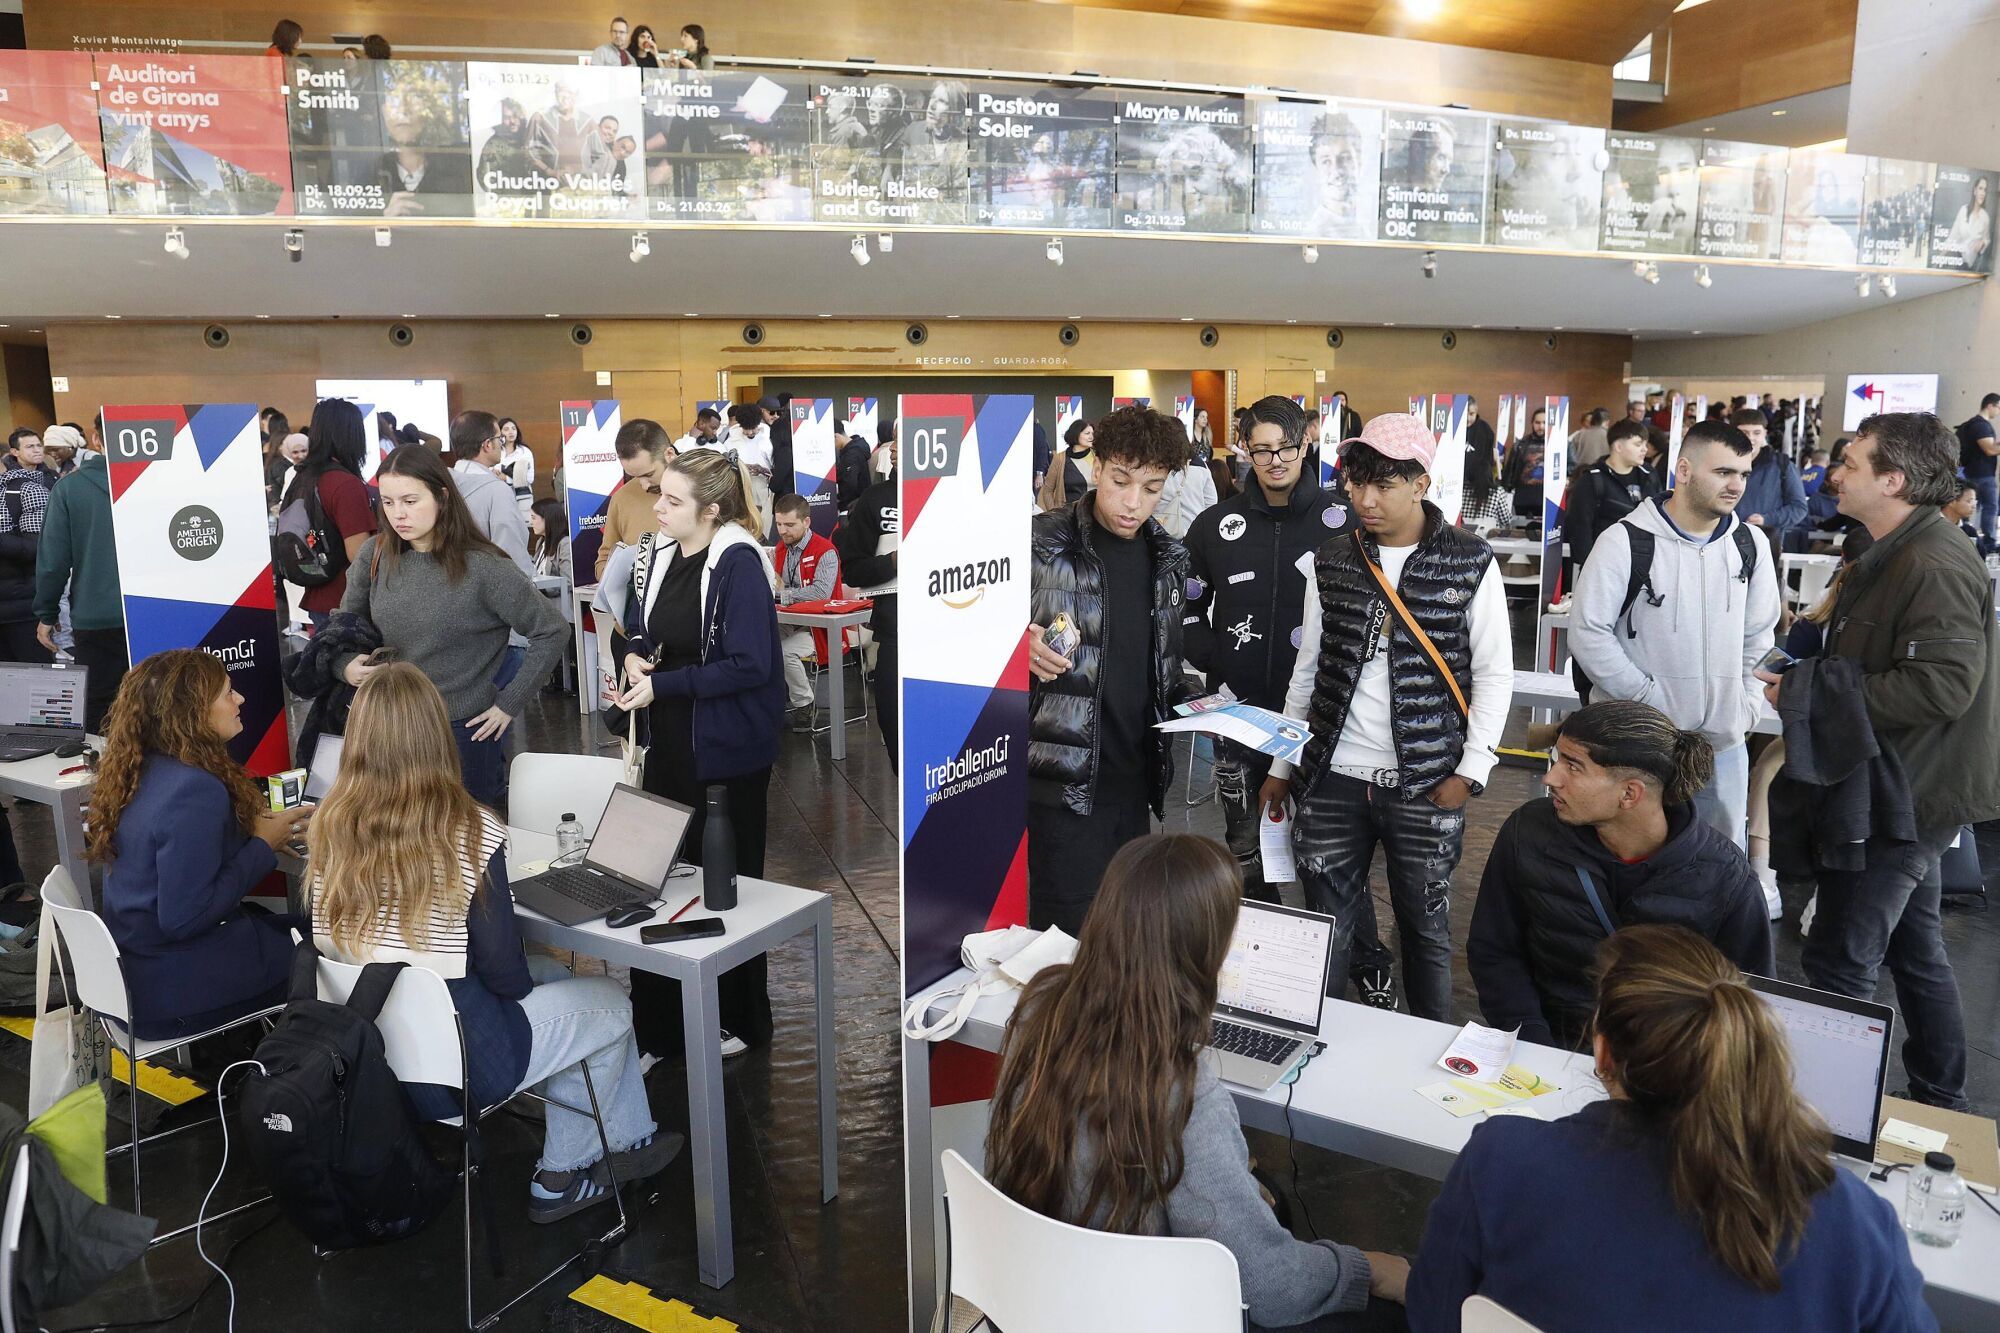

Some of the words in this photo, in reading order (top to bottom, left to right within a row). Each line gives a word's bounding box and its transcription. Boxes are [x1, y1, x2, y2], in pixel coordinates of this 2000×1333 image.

[73, 35, 107, 44] Xavier
[112, 36, 183, 46] Montsalvatge
[107, 63, 196, 84] Auditori
[295, 69, 346, 88] Patti
[109, 85, 138, 104] de
[142, 86, 219, 106] Girona
[653, 79, 712, 98] Maria
[842, 86, 889, 99] 28.11.25
[298, 90, 359, 110] Smith
[978, 94, 1060, 117] Pastora
[653, 101, 720, 119] Jaume
[1125, 102, 1180, 123] Mayte
[1183, 105, 1239, 125] Martín
[110, 107, 153, 127] vint
[157, 112, 211, 133] anys
[978, 117, 1033, 138] Soler
[483, 170, 560, 190] Chucho
[564, 171, 633, 192] Valdés
[327, 185, 383, 198] 18.09.25
[822, 179, 881, 200] Butler,
[887, 180, 939, 199] Blake
[1387, 186, 1449, 205] Simfonia
[306, 198, 327, 209] Dv.
[332, 198, 386, 210] 19.09.25
[485, 192, 542, 212] Royal
[549, 193, 629, 212] Quartet
[657, 202, 676, 212] Ds.
[679, 202, 731, 213] 21.03.26
[822, 200, 859, 216] and
[865, 201, 919, 217] Grant
[978, 209, 995, 219] Dv.
[1124, 214, 1142, 226] Dg.
[1145, 215, 1186, 226] 21.12.25
[1386, 206, 1409, 220] del
[1413, 208, 1439, 221] nou
[1502, 208, 1547, 225] Valeria
[1386, 222, 1416, 237] OBC
[1501, 225, 1542, 240] Castro
[993, 357, 1068, 365] GUARDA-ROBA
[795, 407, 805, 419] 16
[851, 404, 859, 412] 22
[569, 411, 579, 425] 11
[1436, 410, 1445, 429] 09
[118, 427, 159, 457] 06
[913, 428, 948, 471] 05
[578, 453, 617, 463] BAUHAUS
[177, 527, 217, 538] AMETLLER
[177, 535, 217, 548] ORIGEN
[928, 555, 1011, 597] amazon
[226, 660, 256, 671] GIRONA
[925, 734, 1011, 791] treballemGi
[925, 791, 943, 806] FIRA
[943, 773, 983, 799] D'OCUPACIÓ
[983, 765, 1008, 783] GIRONA
[268, 1123, 282, 1131] FACE
